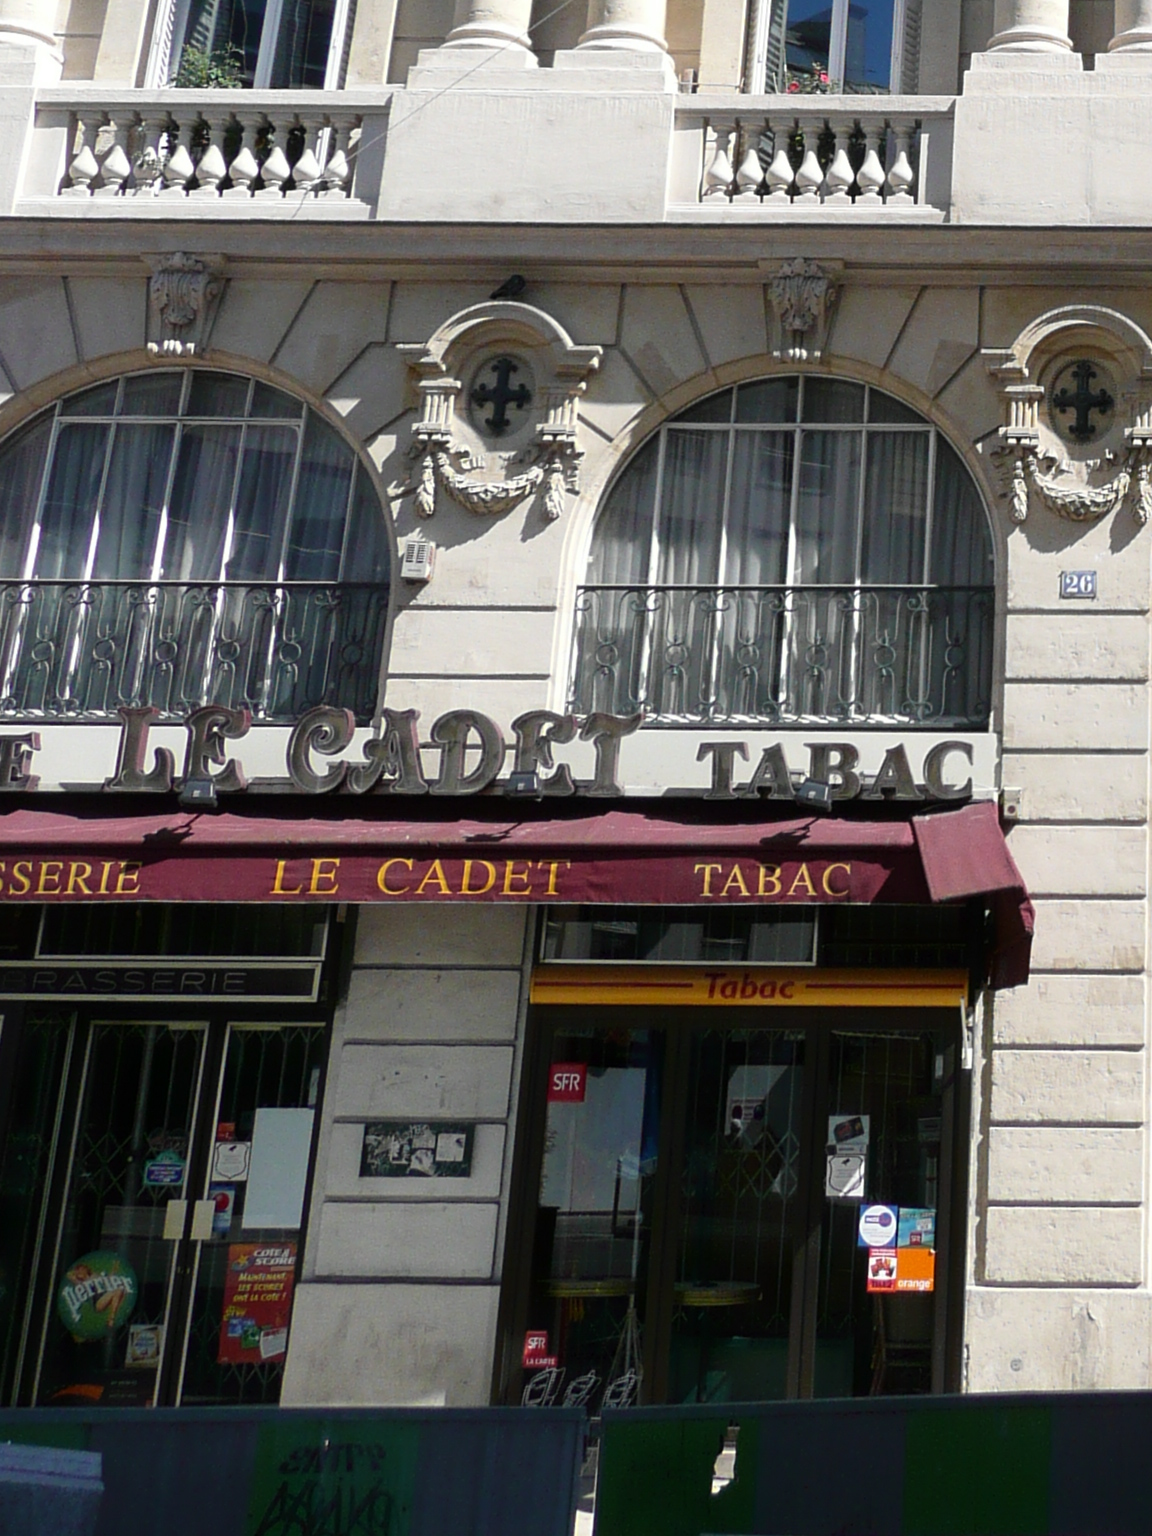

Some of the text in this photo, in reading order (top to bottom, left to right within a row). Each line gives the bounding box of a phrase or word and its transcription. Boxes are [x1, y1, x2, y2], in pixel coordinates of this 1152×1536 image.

[1065, 574, 1093, 593] 26
[104, 705, 253, 793] LE
[286, 705, 645, 798] CADET
[696, 740, 976, 801] TABAC
[269, 857, 342, 897] LE
[376, 857, 571, 897] CADET
[694, 862, 853, 898] TABAC
[1, 970, 249, 994] BRASSERIE
[704, 971, 796, 1001] Tabac
[552, 1072, 581, 1092] SFR
[254, 1256, 297, 1266] SCORE
[897, 1279, 931, 1291] orange
[527, 1336, 546, 1350] SFR
